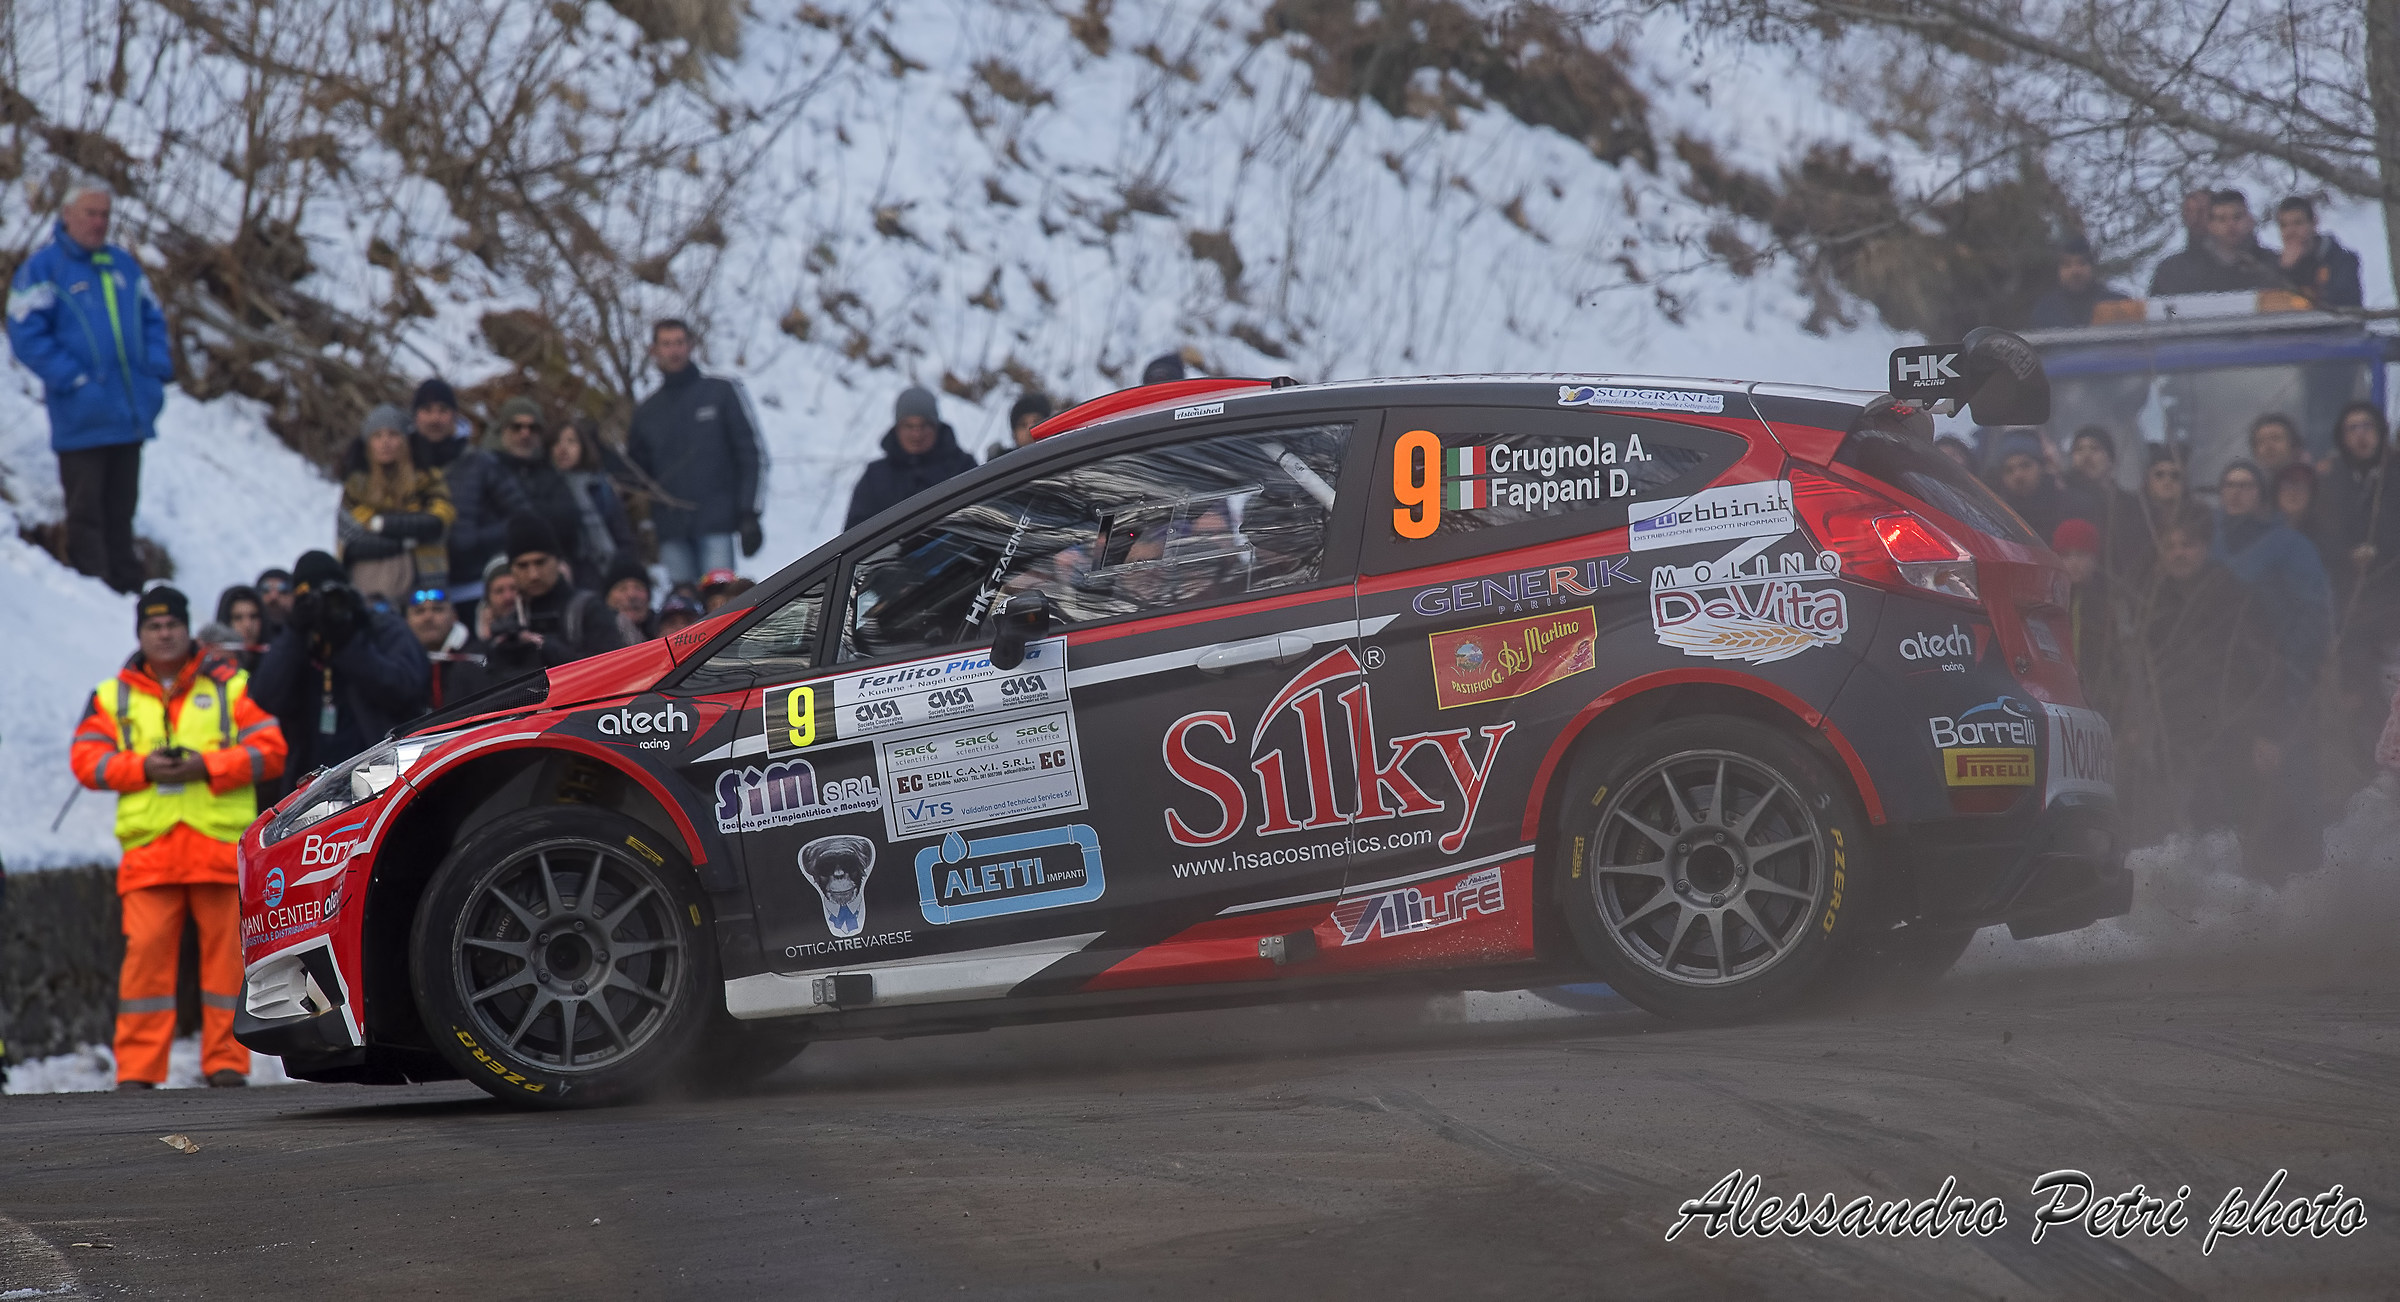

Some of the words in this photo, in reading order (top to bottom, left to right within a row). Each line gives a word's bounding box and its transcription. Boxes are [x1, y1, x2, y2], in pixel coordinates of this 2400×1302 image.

[1897, 353, 1960, 381] HK
[1913, 379, 1946, 387] RACING
[1596, 389, 1706, 403] SUDGRANI
[1490, 437, 1616, 476] Crugnola
[1624, 433, 1652, 462] A.
[1393, 430, 1441, 539] 9
[1491, 470, 1599, 512] Fappani
[1609, 468, 1637, 497] D.
[1634, 528, 1693, 541] DISTRIBUZIONE
[1695, 522, 1735, 533] PRODOTTI
[1737, 517, 1788, 528] INFORMATICI
[965, 583, 996, 626] HK
[992, 514, 1031, 583] RACING
[1412, 556, 1642, 616] GENERIK
[1655, 554, 1838, 588] MOLINO
[1499, 595, 1567, 614] PARIS
[1451, 678, 1493, 694] PASTIFICIO
[1498, 640, 1526, 677] Di
[1518, 620, 1579, 672] Martino
[1899, 624, 1972, 661] atech
[858, 667, 941, 690] Ferlito
[945, 649, 1042, 674] Phaa
[868, 686, 905, 697] Kuehne
[918, 677, 946, 688] Nagel
[949, 670, 995, 682] Company
[1941, 662, 1966, 673] racing
[597, 703, 688, 735] atech
[788, 686, 816, 747] 9
[1929, 716, 2037, 748] Barrelli
[639, 738, 671, 750] racing
[956, 743, 999, 756] scientifica
[1017, 733, 1060, 745] scientifica
[1162, 645, 1515, 854] Silky
[895, 754, 938, 766] scientifica
[897, 774, 923, 794] EC
[927, 771, 953, 782] EDIL
[956, 762, 998, 777] C.A.V.I.
[1002, 757, 1035, 769] S.R.L.
[1039, 750, 1066, 770] EC
[1956, 754, 2030, 778] PIRELLI
[827, 779, 877, 802] SRL
[961, 802, 992, 815] Validation
[994, 801, 1006, 810] and
[1006, 796, 1037, 808] Technical
[1038, 791, 1063, 802] Services
[757, 817, 771, 829] per
[841, 797, 879, 810] Montaggi
[1172, 829, 1433, 879] www.hsacosmetics.com
[944, 858, 1045, 898] ALETTI
[1047, 868, 1085, 883] IMPIANTI
[268, 900, 321, 930] CENTER
